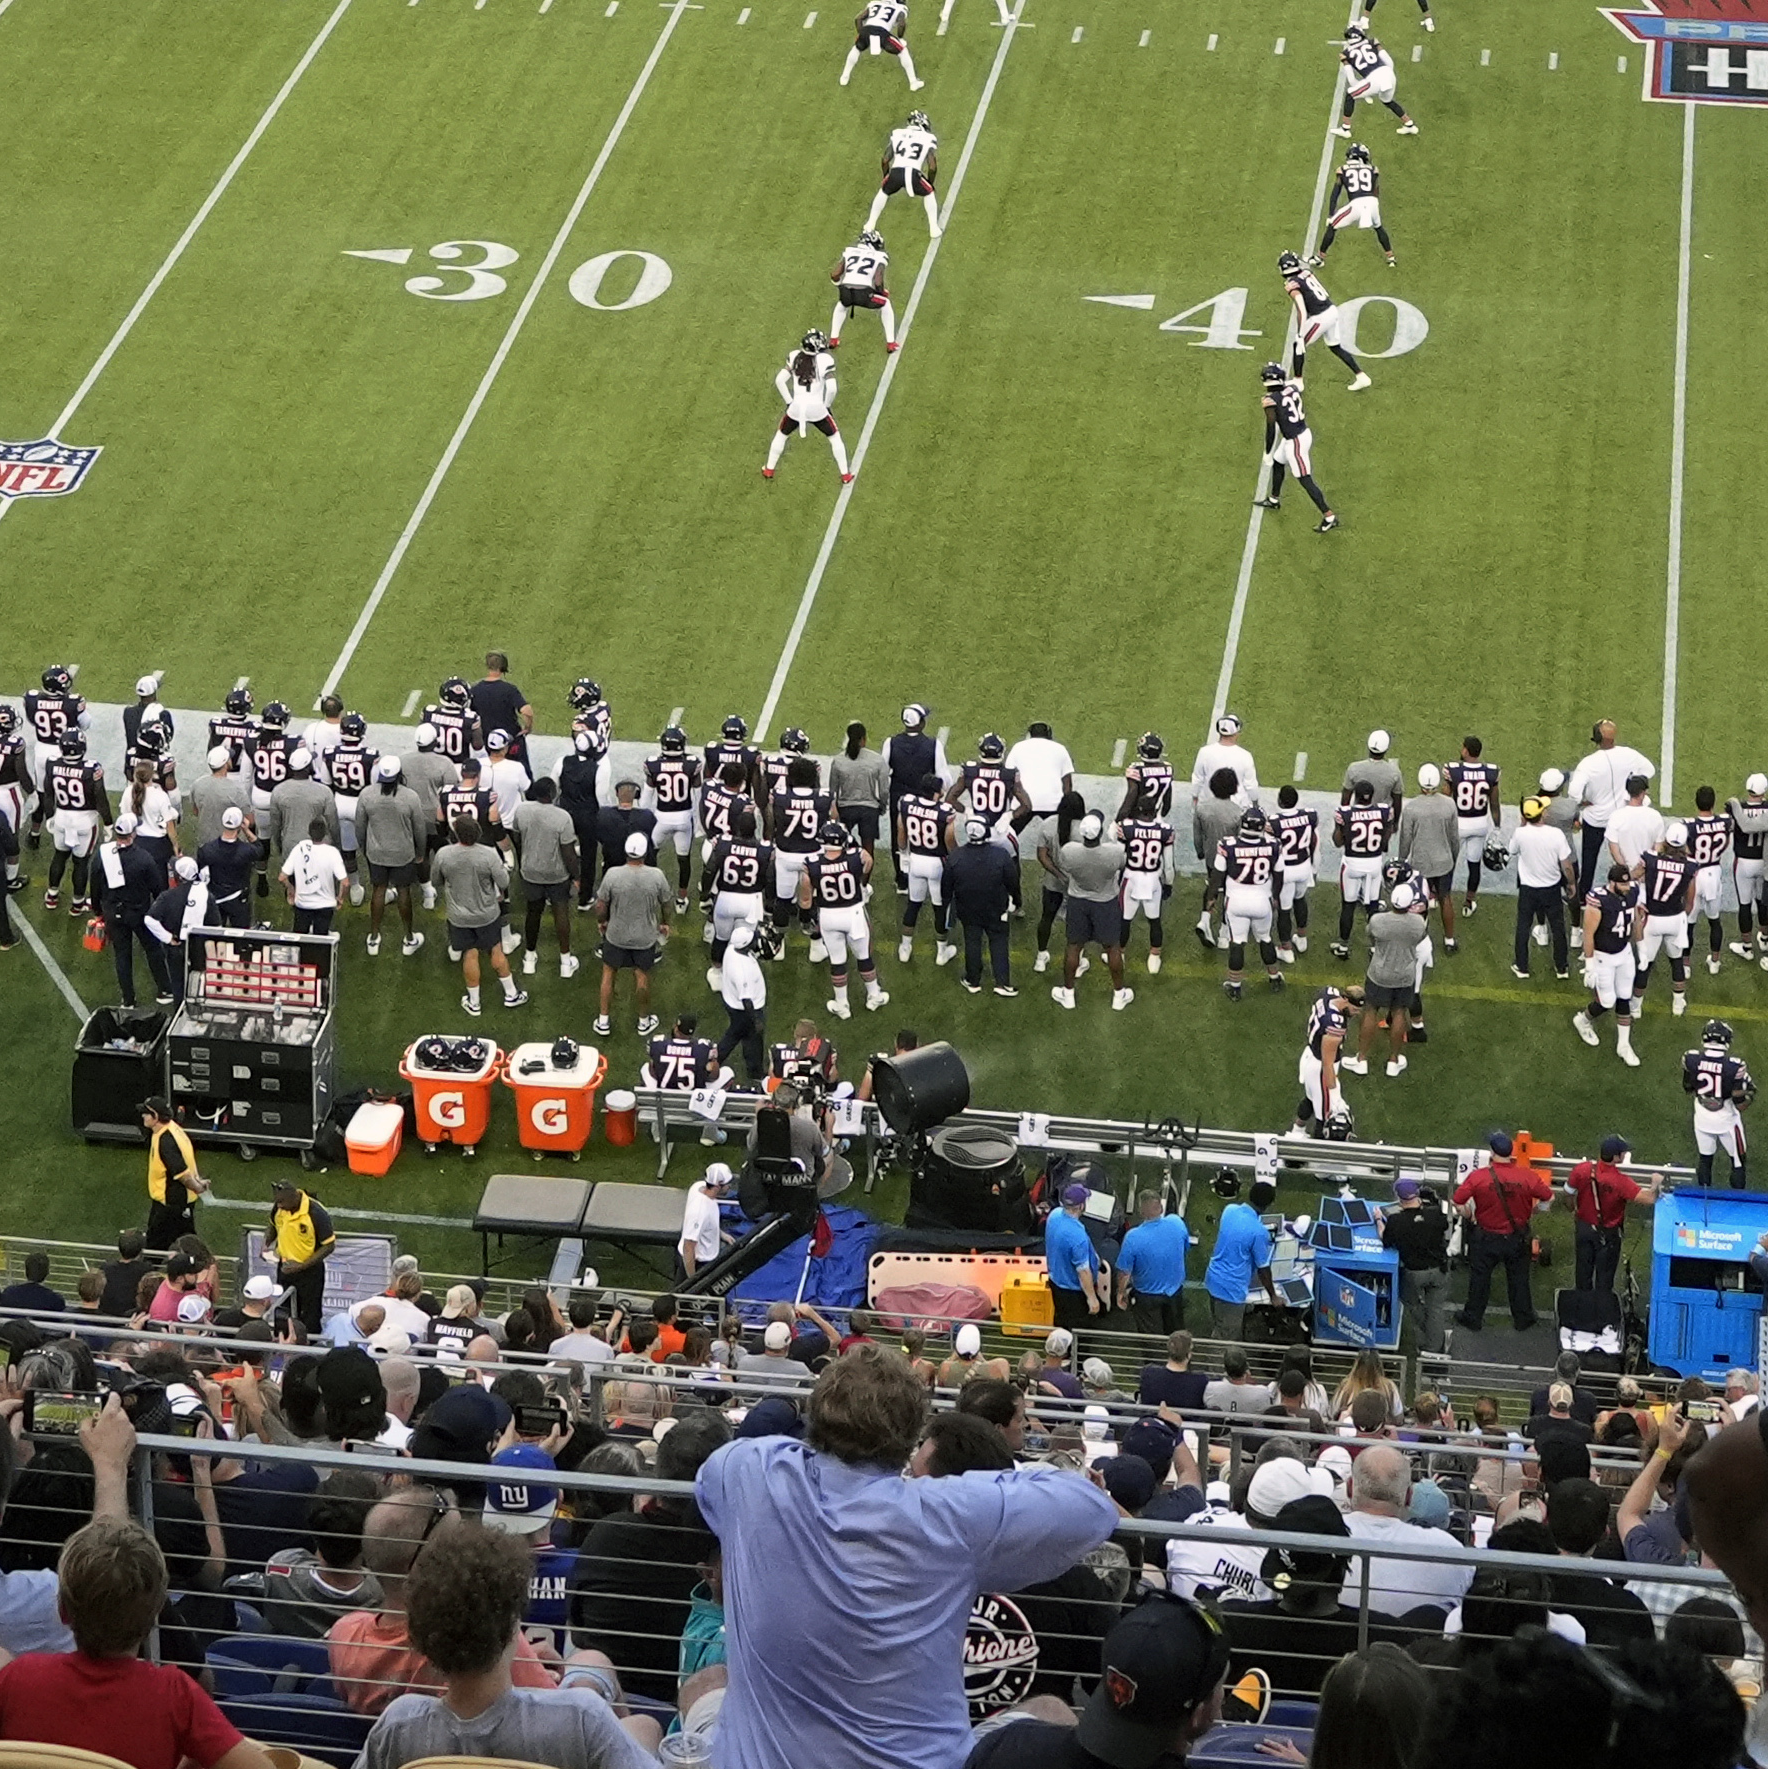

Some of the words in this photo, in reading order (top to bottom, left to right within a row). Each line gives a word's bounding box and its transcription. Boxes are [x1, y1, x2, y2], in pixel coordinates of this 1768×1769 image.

[868, 3, 896, 24] 33
[1348, 44, 1380, 72] 26
[895, 138, 925, 161] 43
[1344, 167, 1374, 194] 39
[842, 254, 876, 278] 22
[34, 710, 67, 738] 93
[253, 751, 286, 780] 96
[332, 762, 365, 788] 59
[54, 780, 86, 808] 69
[657, 773, 689, 802] 30
[972, 778, 1006, 812] 60
[1145, 777, 1171, 809] 27
[1456, 781, 1489, 811] 86
[704, 803, 731, 833] 74
[785, 810, 818, 839] 79
[908, 804, 938, 820] CARLSON
[1350, 810, 1381, 821] JACKSON
[907, 820, 938, 849] 88
[1281, 827, 1312, 861] 24
[1351, 822, 1383, 852] 26
[1129, 841, 1163, 870] 38
[1695, 836, 1727, 863] 82
[724, 857, 759, 886] 63
[1237, 857, 1272, 884] 78
[821, 873, 857, 901] 60
[1652, 872, 1681, 901] 17
[1612, 910, 1636, 938] 47
[660, 1056, 696, 1090] 75
[1696, 1073, 1722, 1096] 21
[428, 1091, 466, 1128] G
[530, 1098, 569, 1135] G
[1698, 1240, 1733, 1252] Surface
[1699, 1230, 1742, 1242] Microsoft
[435, 1324, 474, 1339] MAYFIELD
[1337, 1313, 1374, 1338] Microsoft
[1337, 1324, 1366, 1344] Surface
